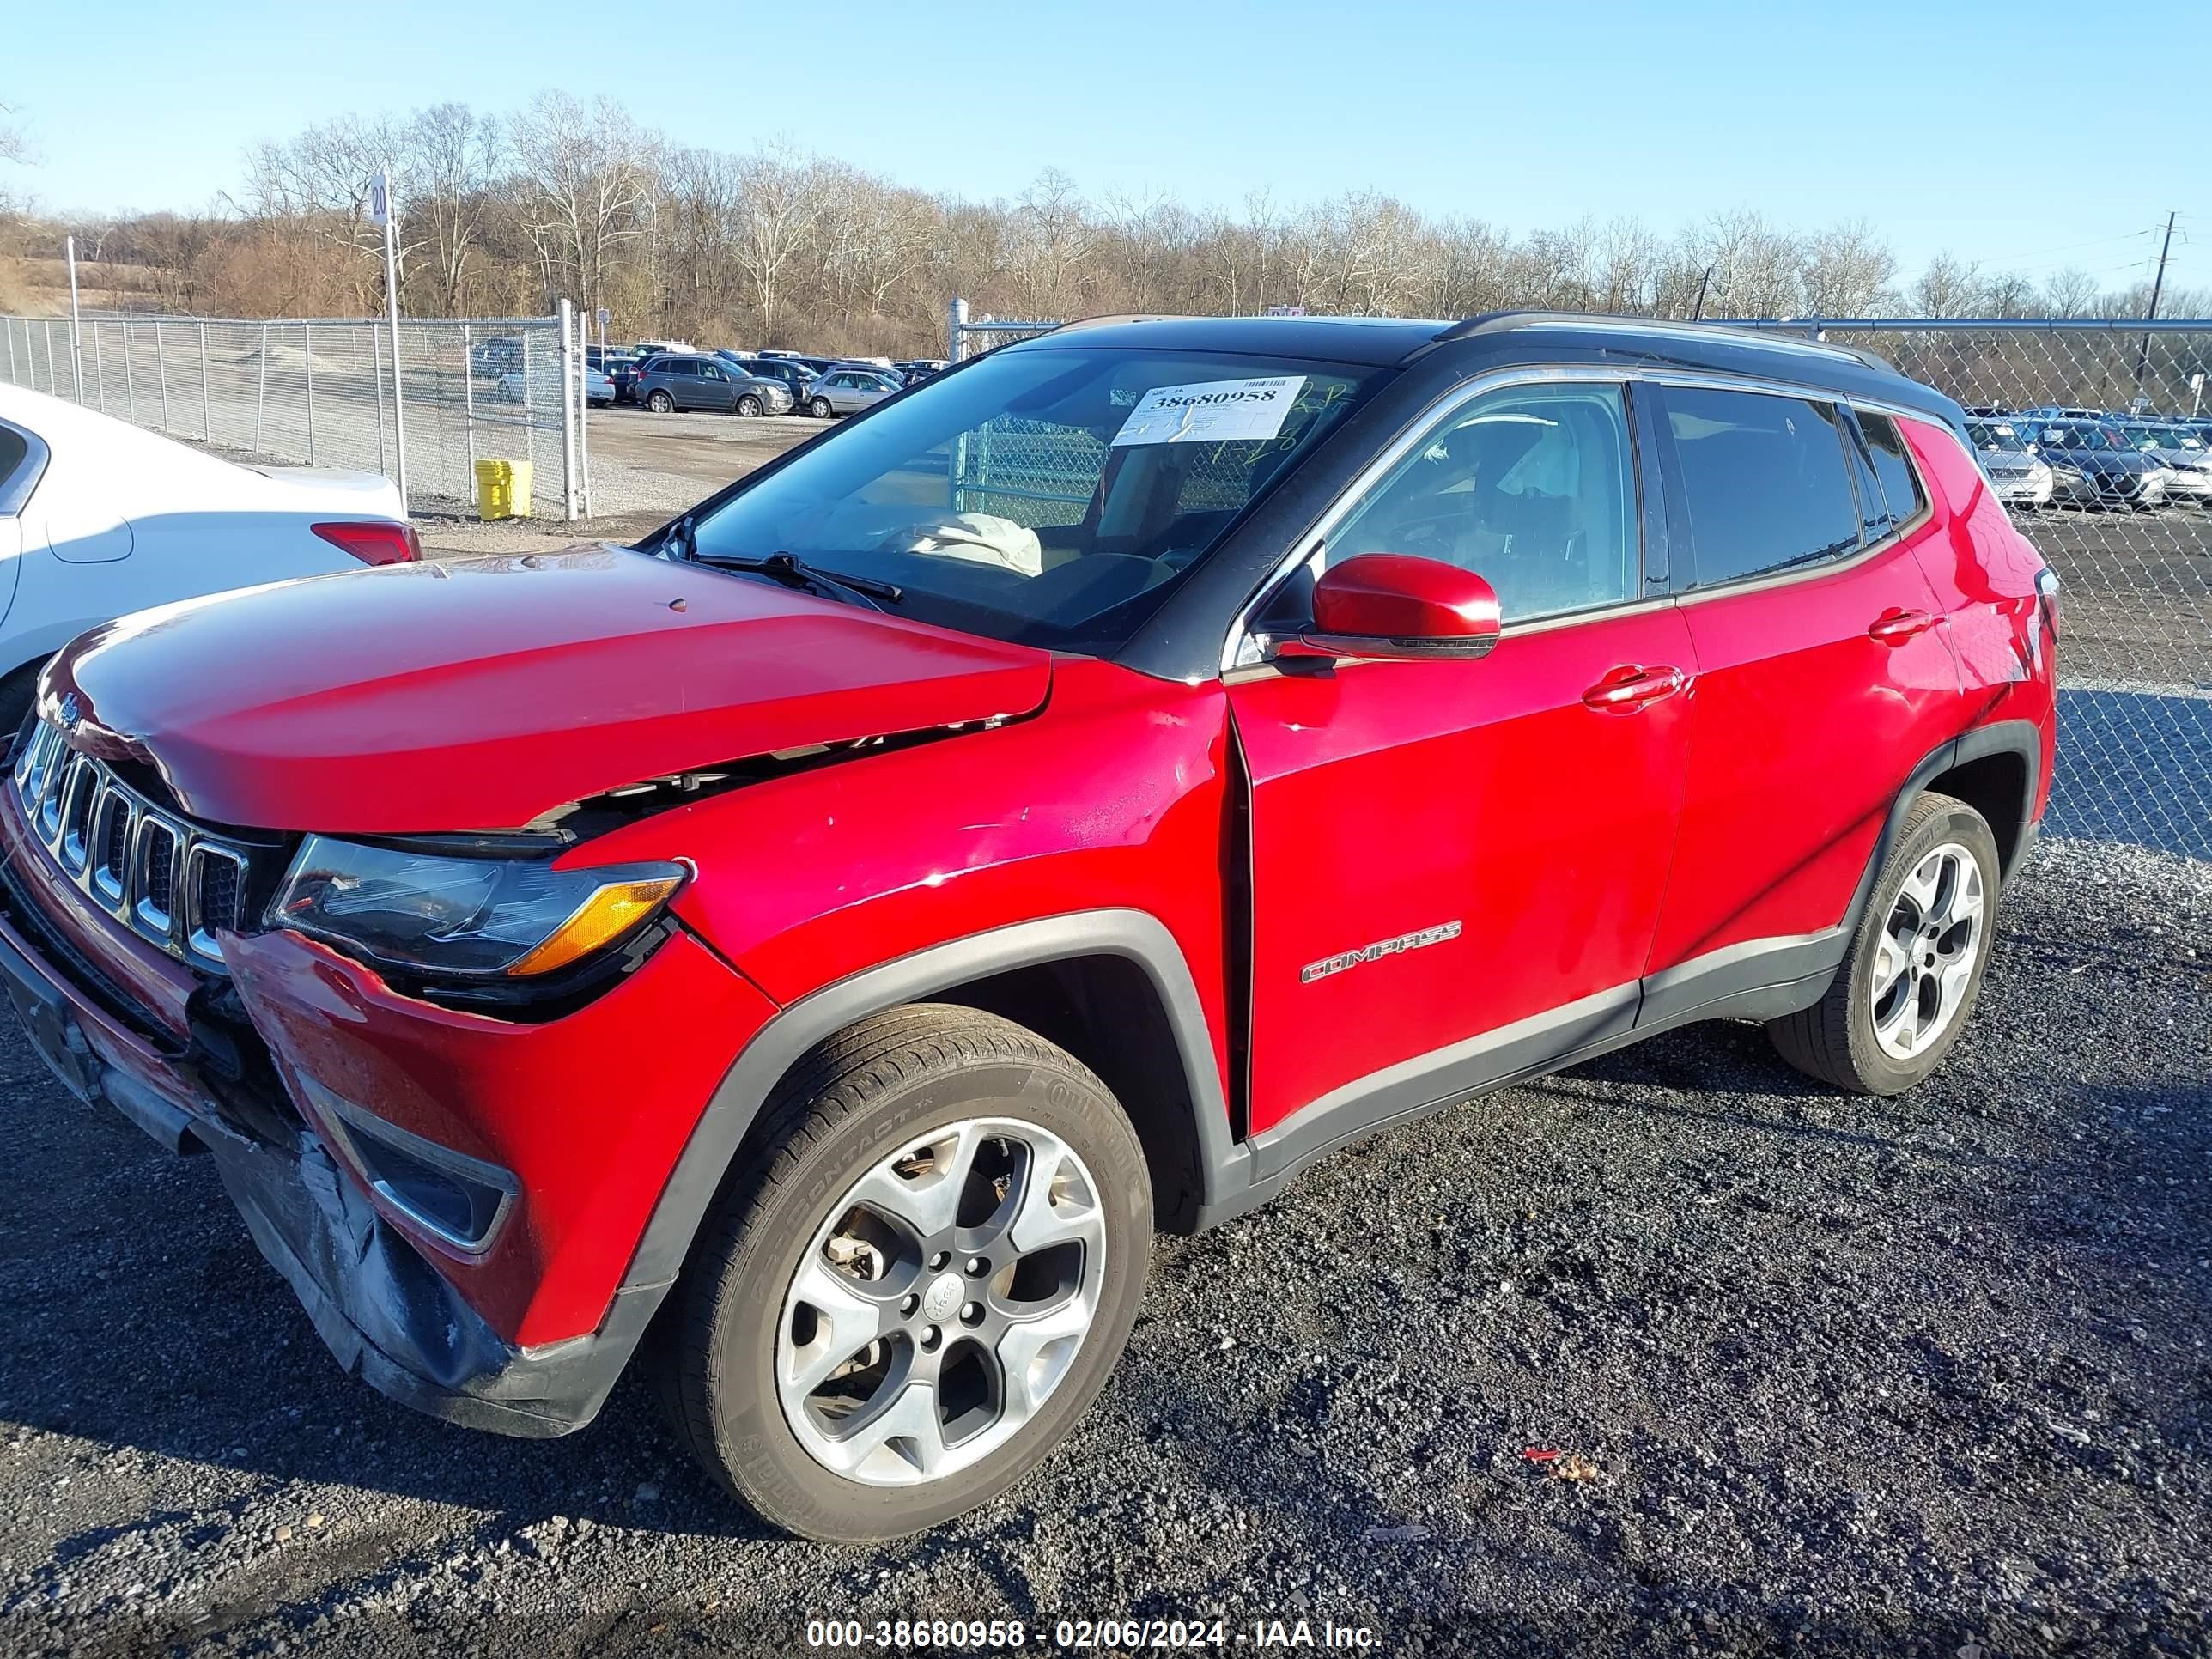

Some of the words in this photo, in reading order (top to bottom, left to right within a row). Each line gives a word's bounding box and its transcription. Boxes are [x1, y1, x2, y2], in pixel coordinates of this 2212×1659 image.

[372, 185, 386, 215] 20
[1150, 389, 1278, 410] 38680958
[1301, 920, 1462, 983] COMPASS
